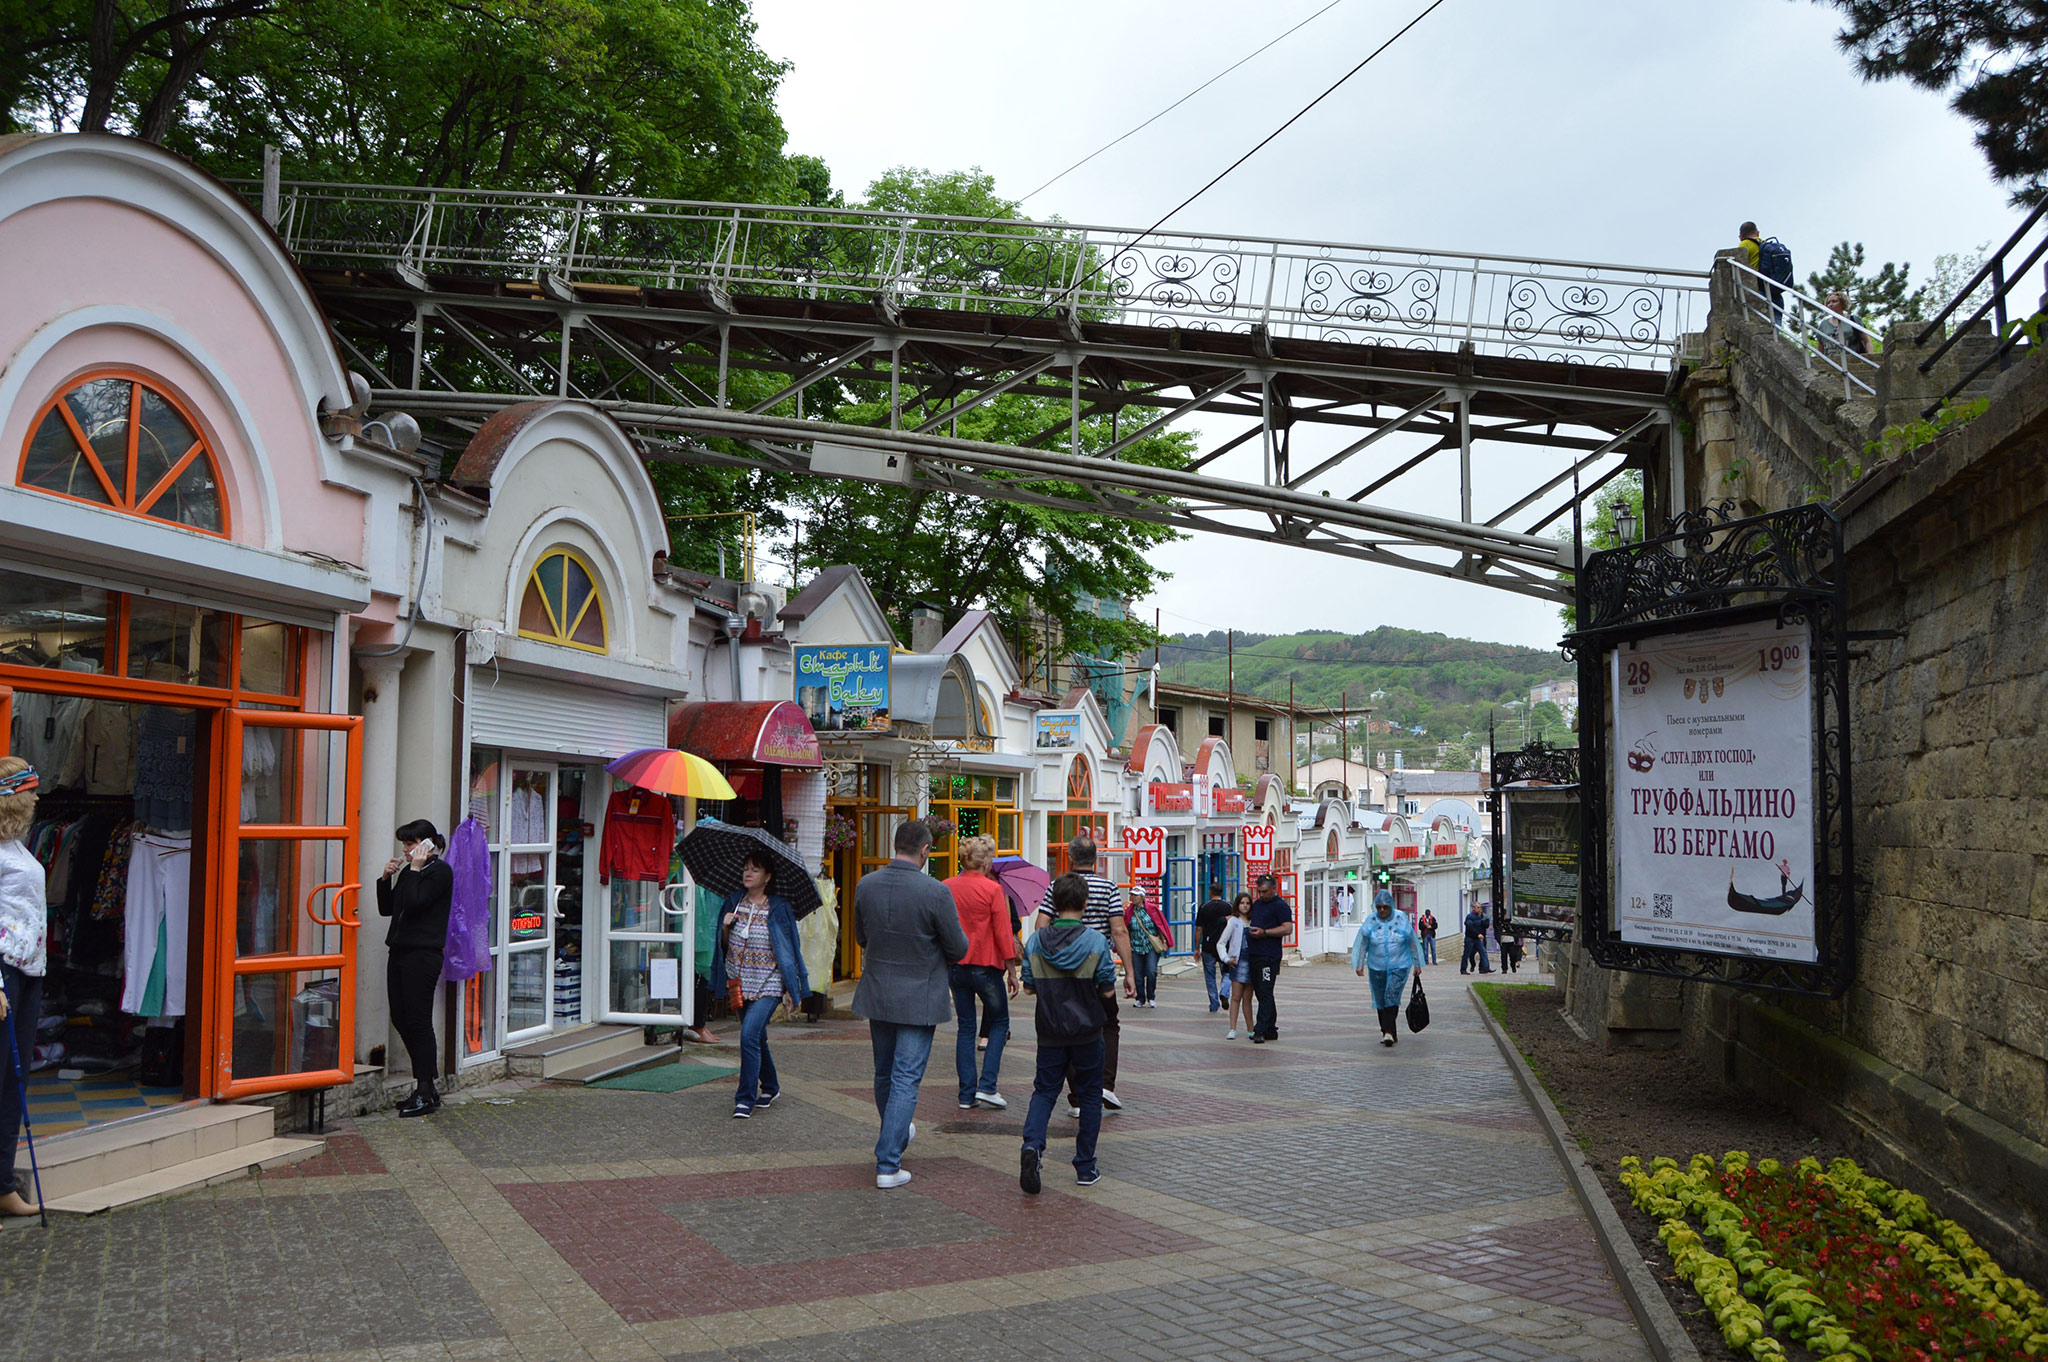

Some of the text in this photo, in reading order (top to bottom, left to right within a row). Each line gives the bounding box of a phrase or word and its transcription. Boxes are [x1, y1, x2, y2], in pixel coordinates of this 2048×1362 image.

[819, 650, 848, 661] Кафе
[800, 651, 884, 676] Старый
[1627, 661, 1651, 686] 28
[829, 675, 883, 707] Баку
[1632, 686, 1646, 695] МАЯ
[1666, 714, 1686, 726] Пьеса
[1692, 713, 1745, 727] музыкальными
[1688, 727, 1723, 738] номерами
[1660, 749, 1756, 766] «СЛУГА ДВУХ ГОСПОД»
[1698, 770, 1714, 781] ИЛИ
[1630, 787, 1796, 824] ТРУФФАЛЬДИНО
[1653, 827, 1775, 860] ИЗ БЕРГАМО
[1631, 896, 1647, 909] 12+
[511, 916, 542, 930] ОТКРЫТО
